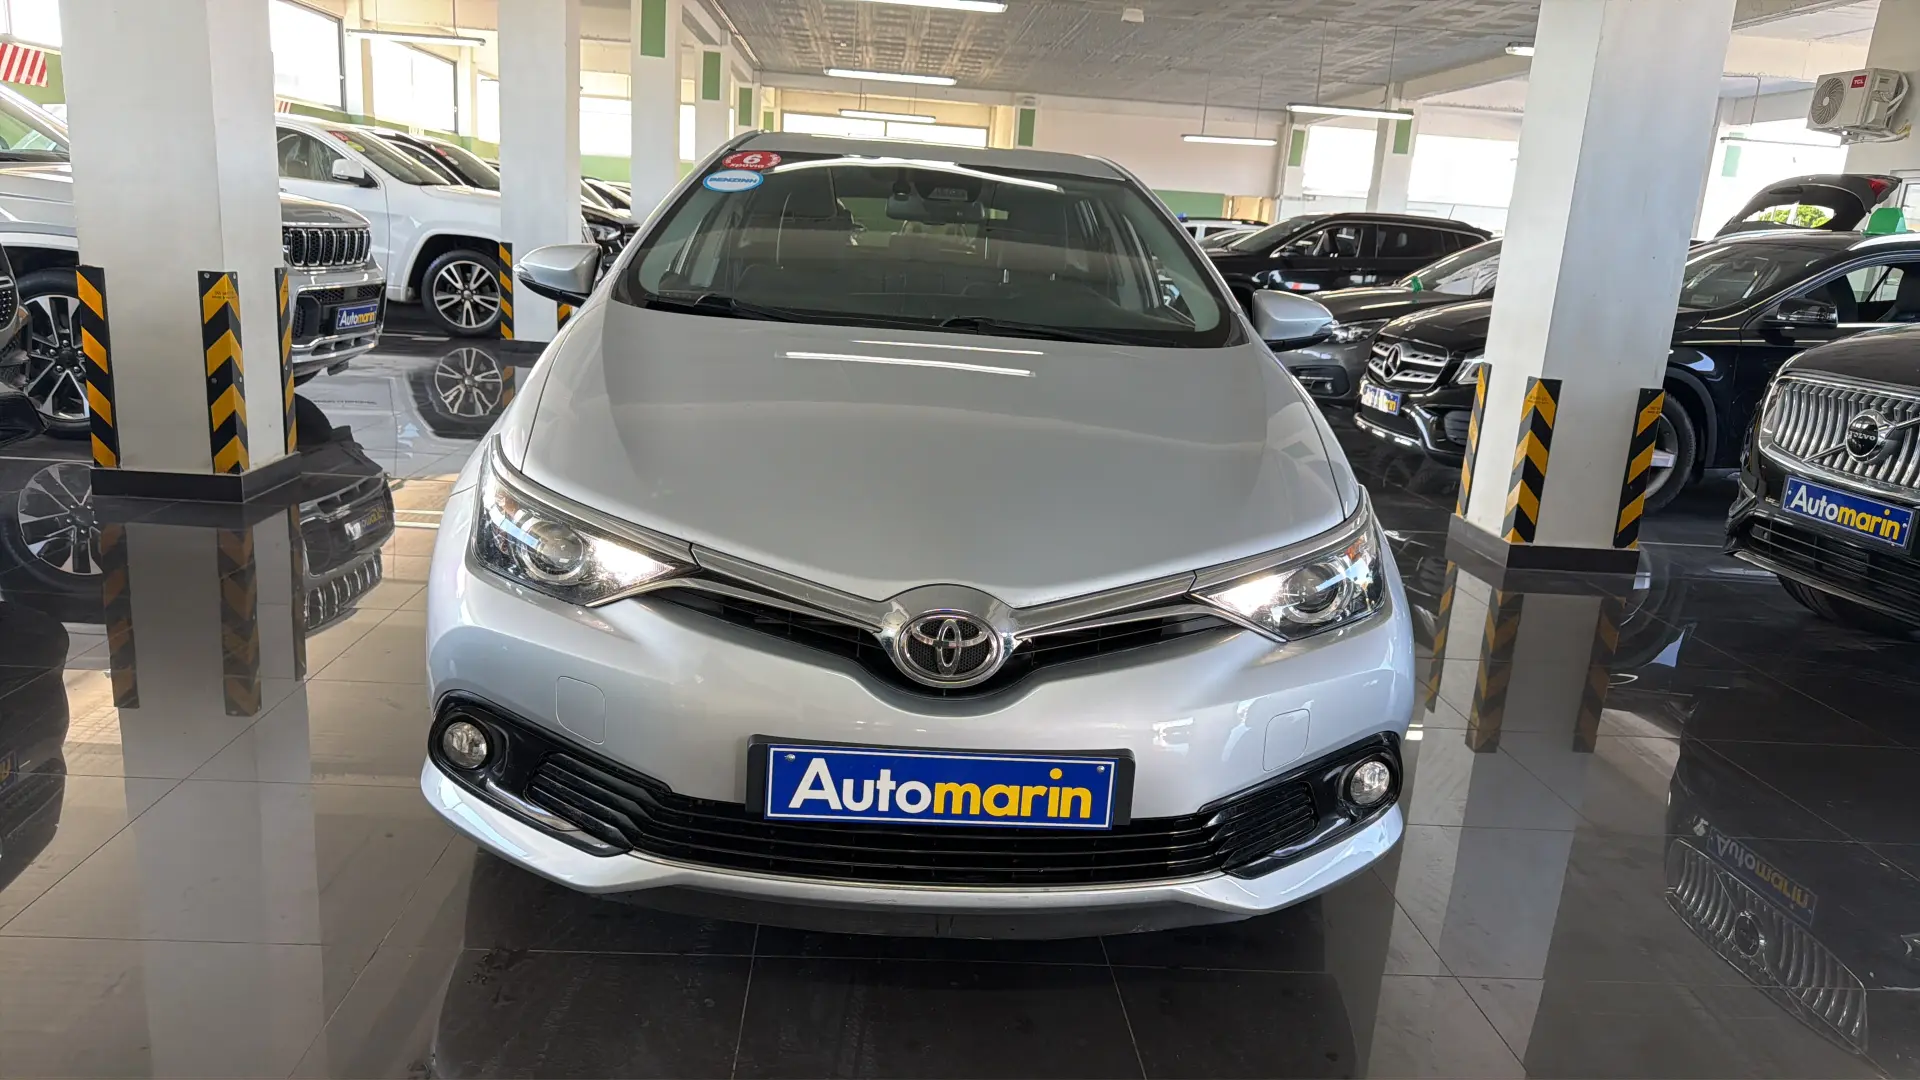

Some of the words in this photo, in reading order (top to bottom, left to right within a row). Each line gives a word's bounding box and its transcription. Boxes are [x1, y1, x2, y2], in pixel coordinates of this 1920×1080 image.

[743, 154, 763, 164] 6
[339, 307, 376, 327] Automarin
[1790, 484, 1900, 540] Automarin
[788, 757, 1092, 819] Automarin
